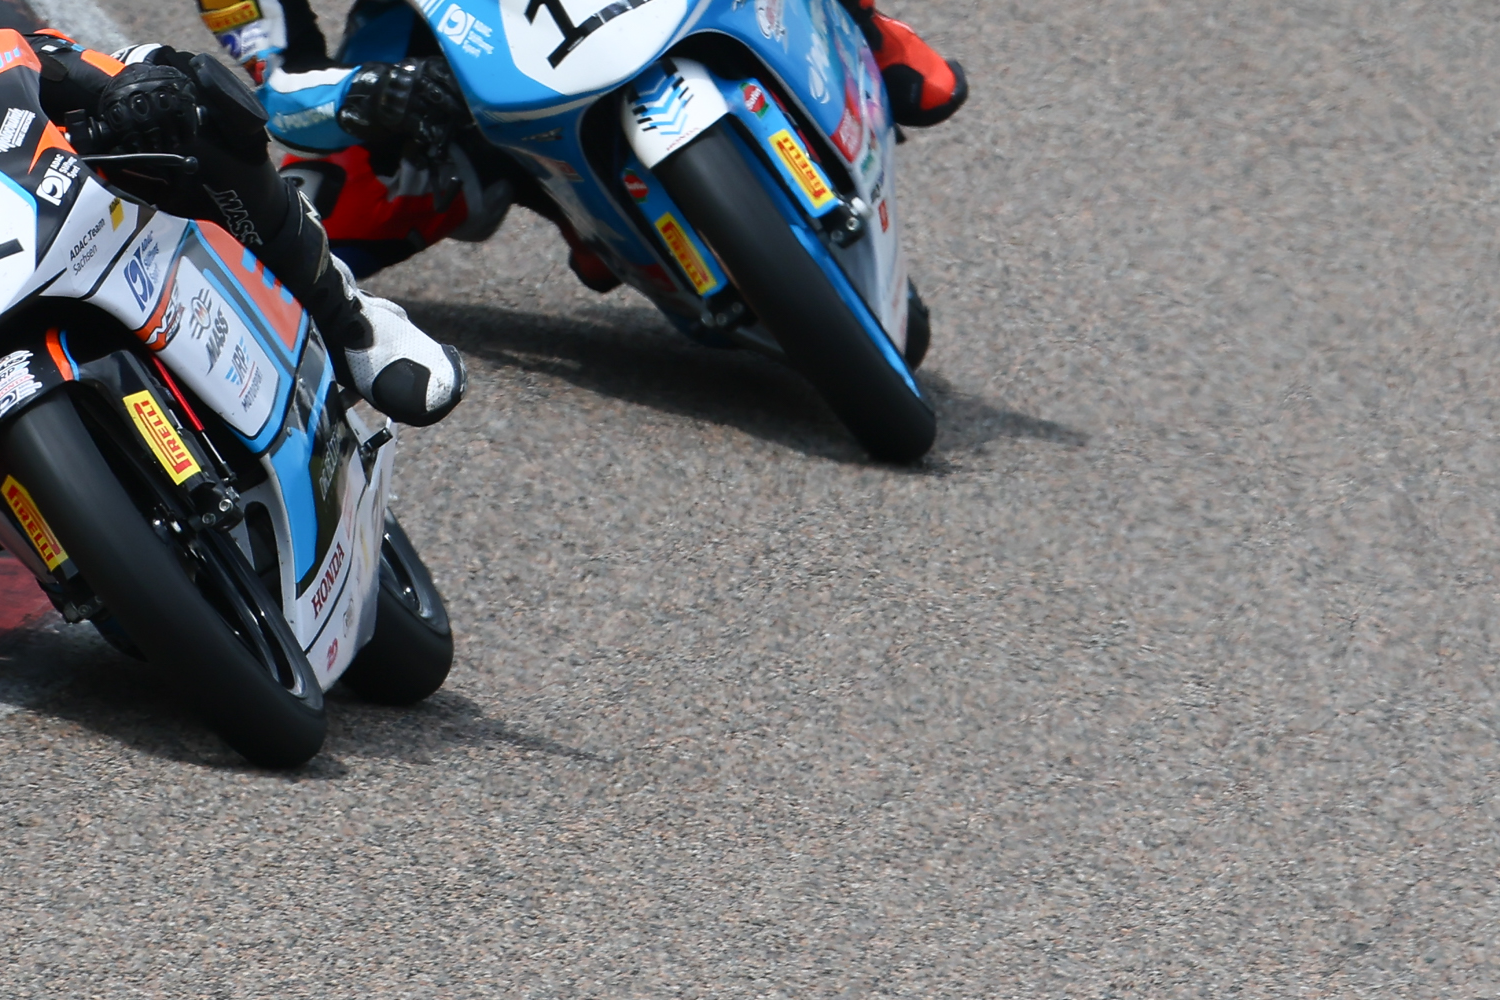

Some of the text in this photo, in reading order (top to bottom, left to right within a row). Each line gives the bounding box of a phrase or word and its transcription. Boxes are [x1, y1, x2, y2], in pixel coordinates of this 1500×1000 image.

[50, 154, 64, 169] ADAC
[66, 165, 81, 178] Sport
[776, 137, 827, 198] PIRELLI
[70, 218, 106, 262] ADAC Team
[202, 184, 264, 245] MASS
[73, 244, 98, 276] Sachsen
[206, 304, 229, 377] MASS
[231, 344, 248, 385] JRP
[133, 400, 193, 475] PIRELLI
[6, 484, 62, 563] PIRELLI
[312, 541, 346, 621] HONDA
